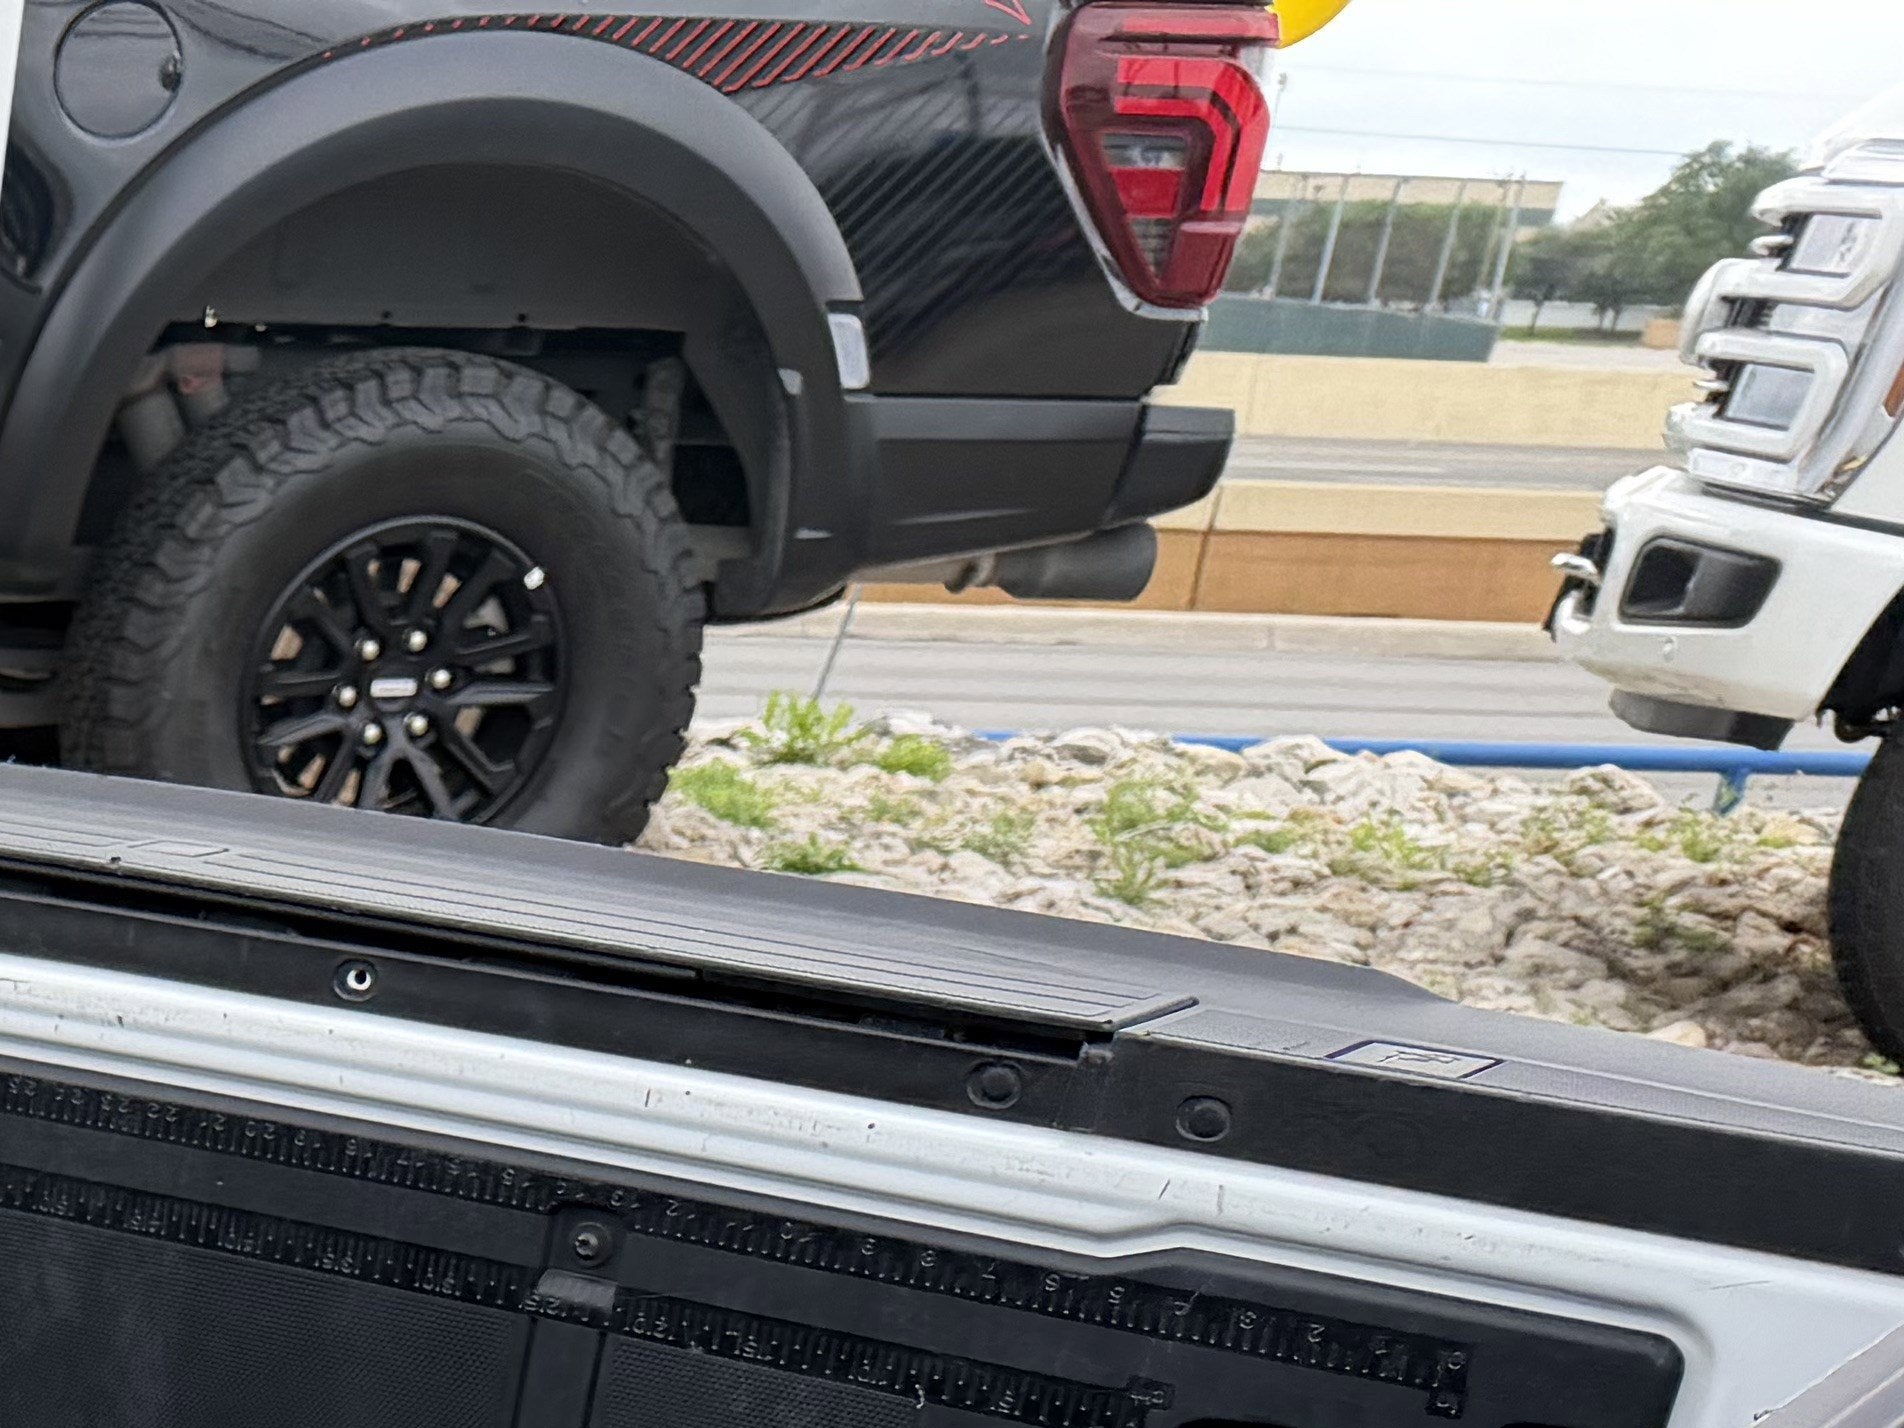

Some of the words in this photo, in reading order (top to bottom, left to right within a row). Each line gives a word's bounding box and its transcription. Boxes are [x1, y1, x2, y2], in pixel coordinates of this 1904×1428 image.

[1045, 1272, 1059, 1292] 6
[1108, 1284, 1124, 1304] 5
[1239, 1309, 1256, 1330] 3
[1307, 1322, 1324, 1343] 2
